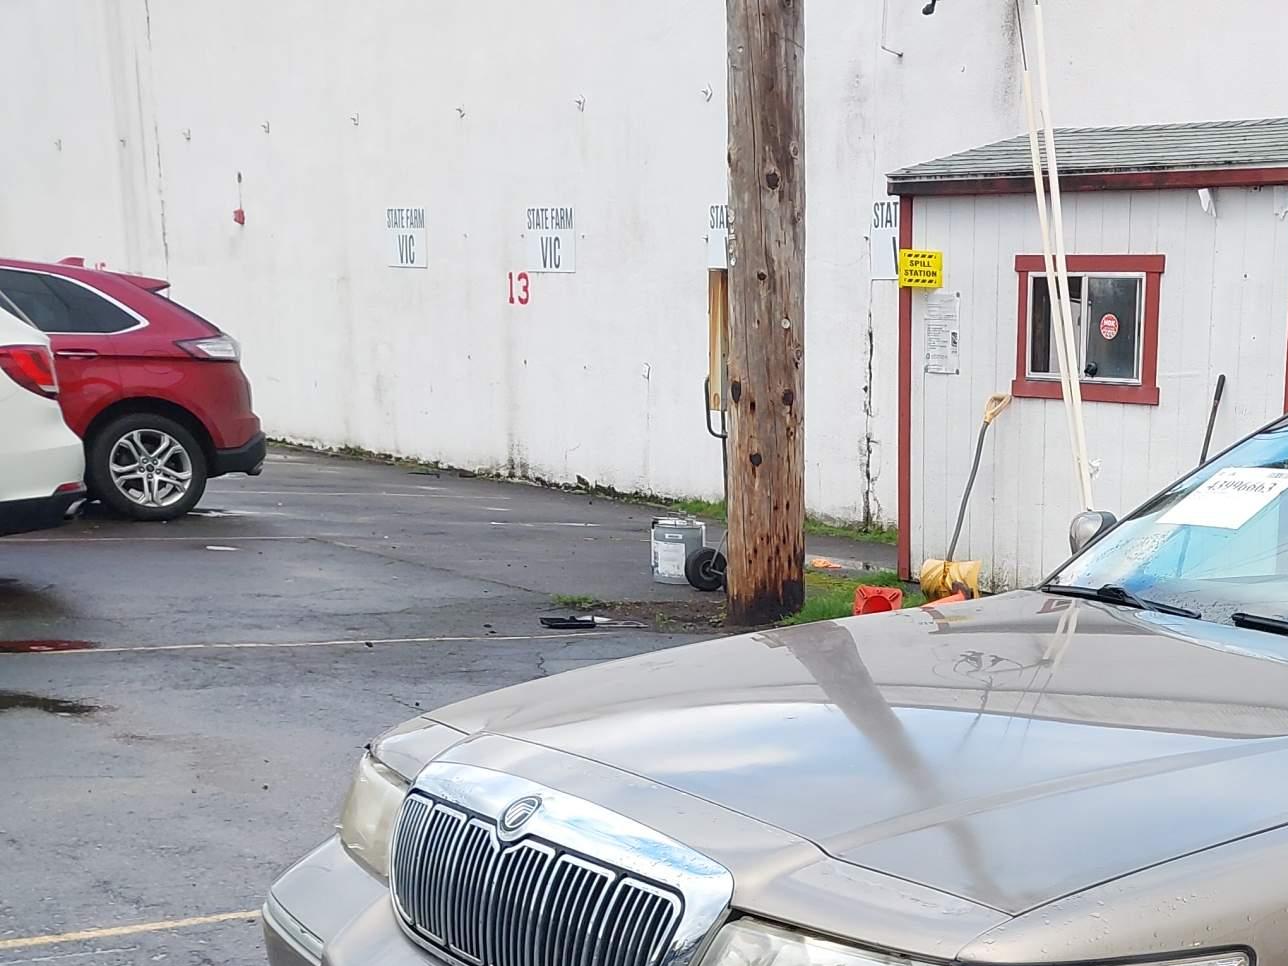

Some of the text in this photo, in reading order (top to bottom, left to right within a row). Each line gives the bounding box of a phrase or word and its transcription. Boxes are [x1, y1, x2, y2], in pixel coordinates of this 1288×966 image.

[387, 208, 424, 228] STATE FARM
[528, 208, 572, 229] STATE FARM
[710, 204, 728, 229] STAT
[874, 202, 899, 228] STAT
[398, 235, 415, 264] VIC
[541, 237, 560, 268] VIC
[904, 269, 937, 278] STATION
[909, 259, 932, 267] SPILL
[509, 272, 529, 305] 13
[1207, 481, 1277, 494] 43996663
